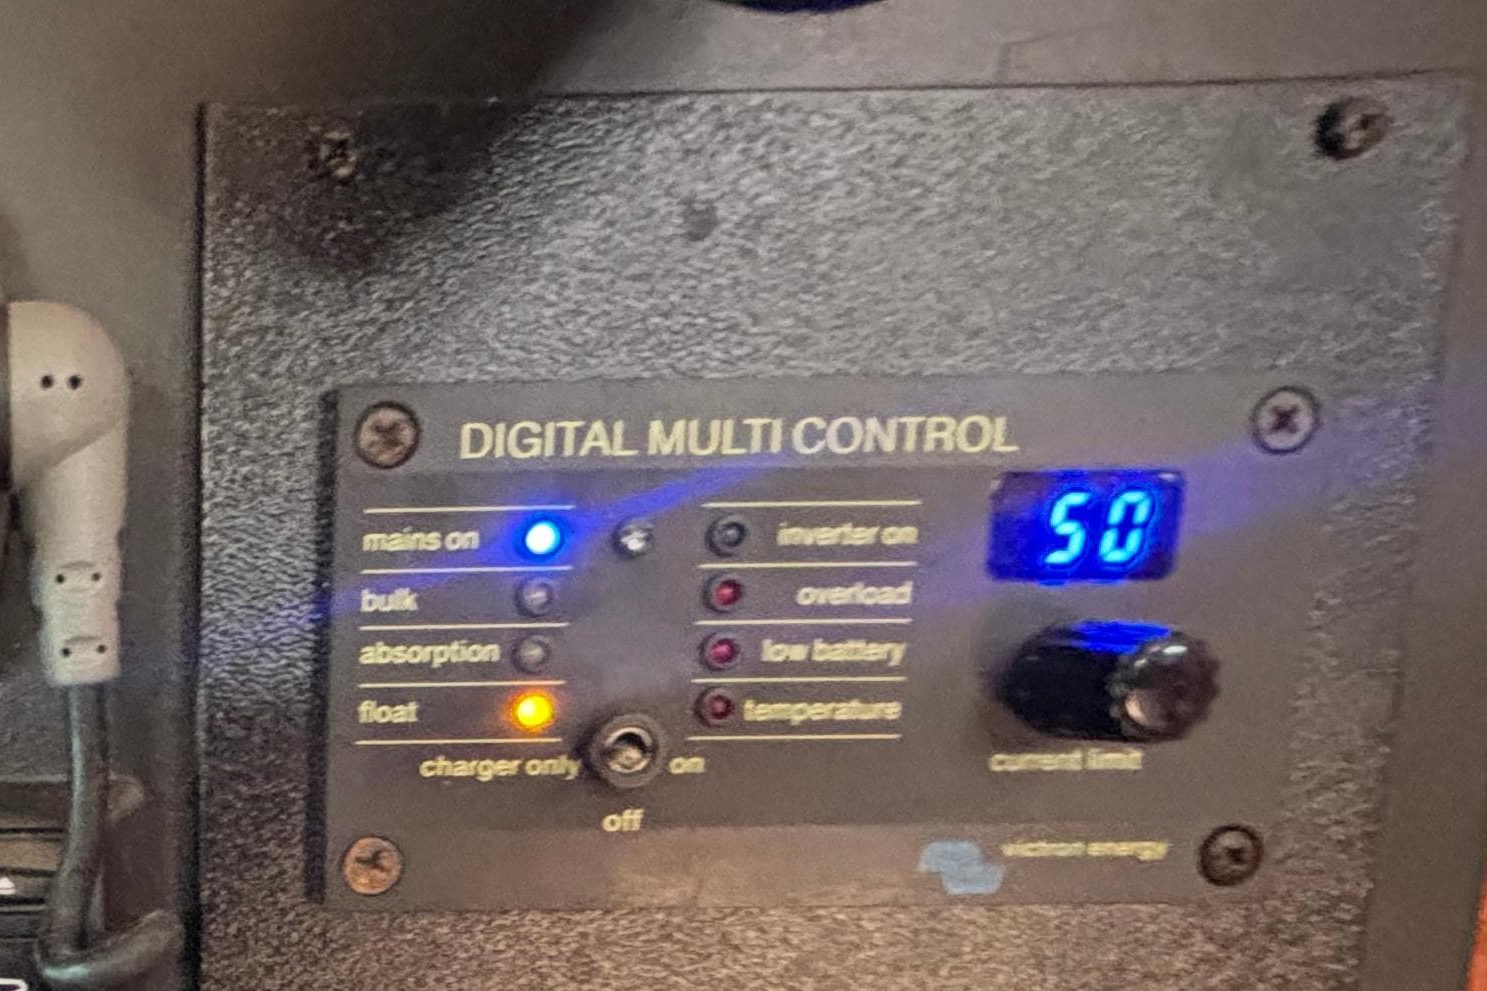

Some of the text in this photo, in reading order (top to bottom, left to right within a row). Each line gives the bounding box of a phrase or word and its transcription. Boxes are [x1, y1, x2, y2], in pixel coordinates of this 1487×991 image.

[460, 415, 1020, 459] DIGITAL MULTI CONTROL
[363, 527, 480, 552] mains on
[776, 521, 919, 546] inverter on
[1045, 490, 1152, 564] 50
[361, 587, 418, 612] bulk
[796, 581, 913, 606] overload
[359, 640, 501, 668] absorption
[761, 638, 907, 667] low battery
[358, 700, 419, 724] float
[743, 699, 902, 725] temperature
[419, 754, 581, 781] charger only
[668, 756, 706, 774] on
[602, 807, 644, 832] off
